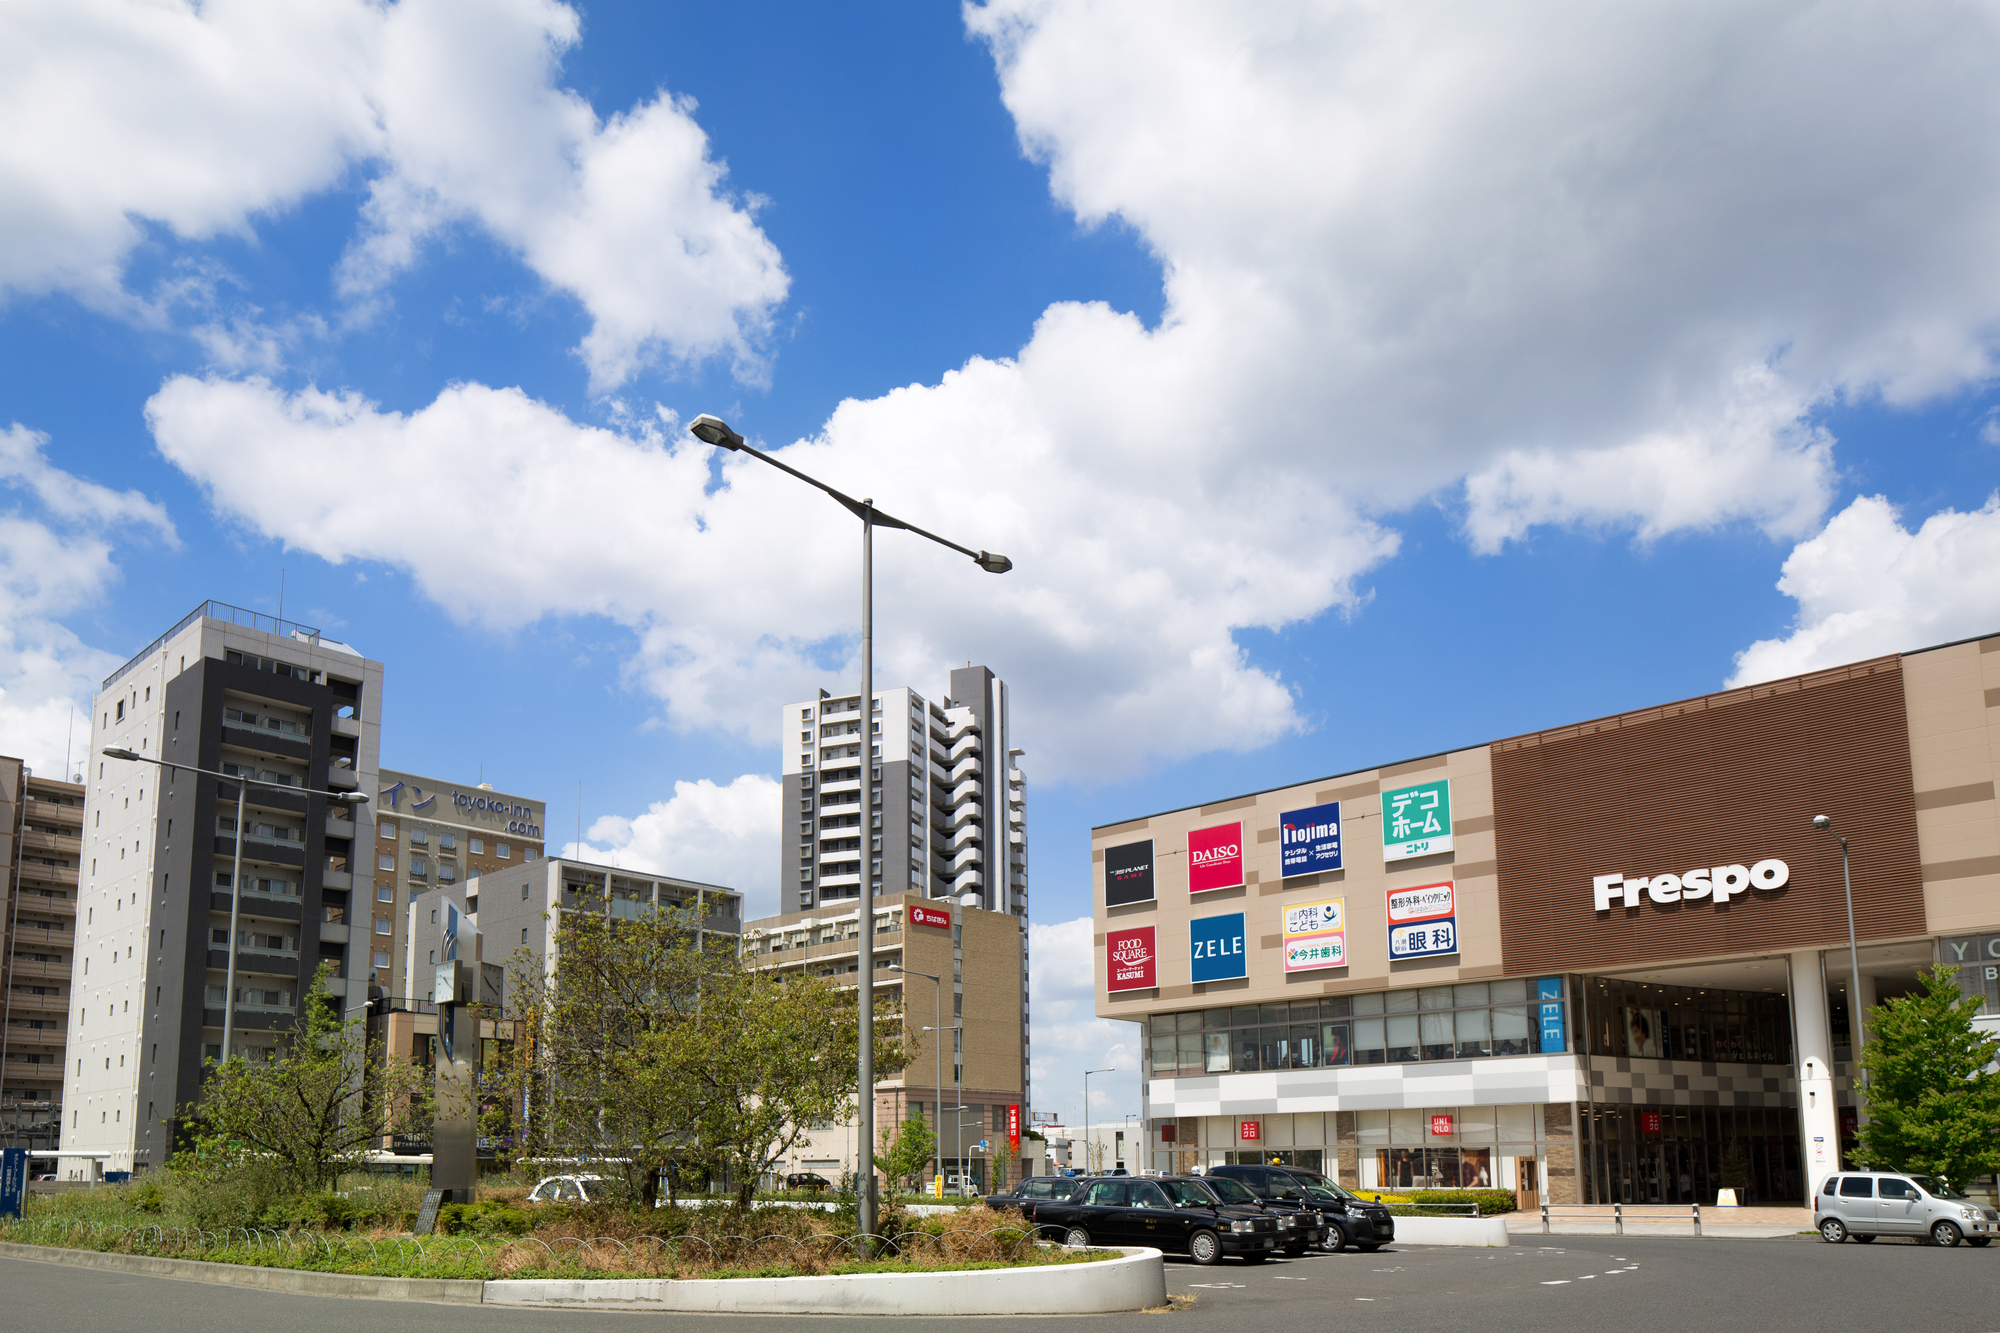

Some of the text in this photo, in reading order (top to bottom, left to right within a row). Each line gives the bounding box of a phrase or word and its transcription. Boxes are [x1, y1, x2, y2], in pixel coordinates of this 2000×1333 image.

[380, 781, 435, 810] イン
[1391, 790, 1439, 818] デコ
[451, 790, 531, 819] toyoko-inn
[503, 820, 539, 837] .com
[1392, 811, 1441, 838] ホーム
[1283, 822, 1338, 845] nojima
[1192, 844, 1238, 862] DAISO
[1406, 842, 1429, 854] ニトリ
[1117, 872, 1143, 880] GAME
[1593, 859, 1790, 911] Frespo
[1299, 907, 1318, 920] 内科
[1289, 920, 1319, 933] こども
[1118, 938, 1142, 950] FOOD
[1194, 936, 1242, 959] ZELE
[1408, 928, 1451, 951] 眼科
[1112, 948, 1148, 961] SQUARE
[1298, 945, 1342, 960] 今井歯科
[1117, 970, 1144, 980] KASUMI
[1542, 990, 1561, 1039] ZELE
[1434, 1125, 1449, 1133] QLO
